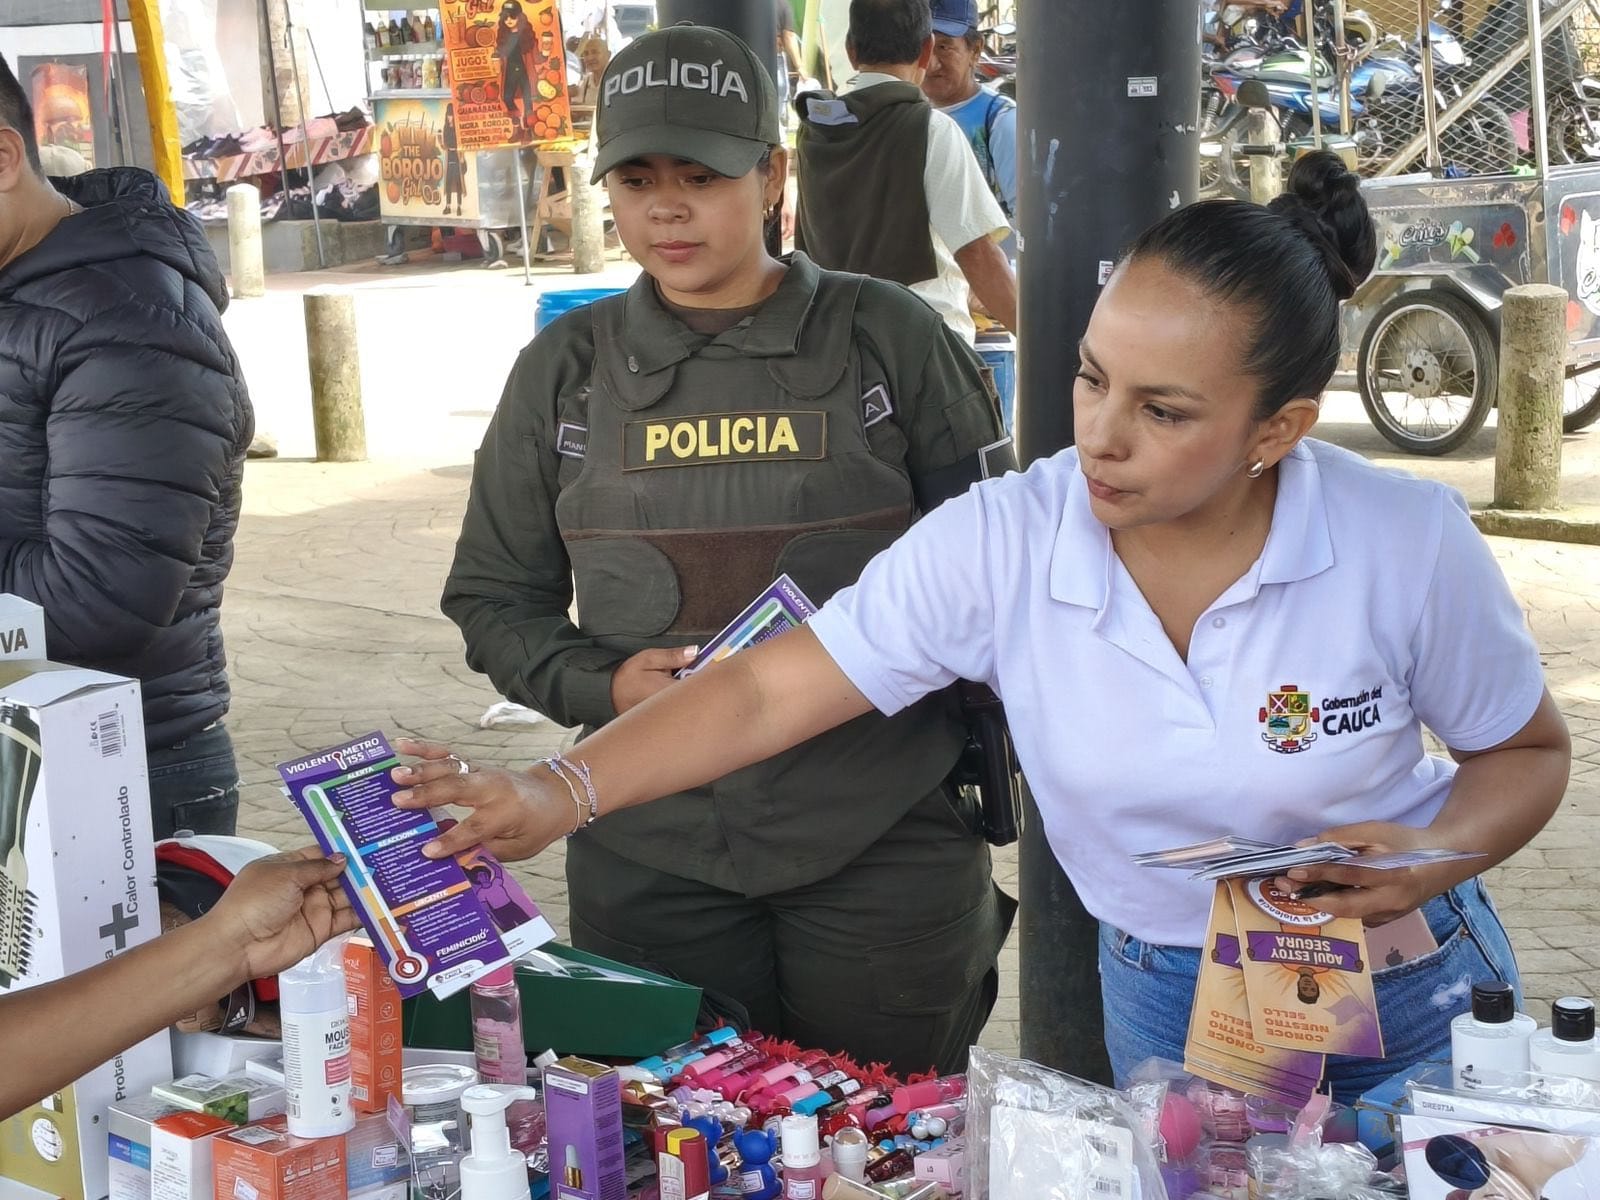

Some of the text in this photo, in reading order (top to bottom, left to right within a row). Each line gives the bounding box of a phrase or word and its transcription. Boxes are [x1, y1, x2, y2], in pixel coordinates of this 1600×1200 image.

[456, 56, 488, 67] JUGOS
[604, 58, 748, 106] POLICÍA
[403, 145, 420, 157] THE
[382, 157, 443, 180] BOROJO
[646, 416, 799, 461] POLICIA
[1322, 704, 1381, 736] CAUCA
[345, 752, 365, 765] 155
[347, 766, 374, 779] ALERTA
[377, 828, 418, 848] REACCIONA
[117, 785, 138, 914] Calor Controlado
[1258, 898, 1300, 923] Violencia
[436, 931, 488, 957] FEMINICIDIO
[1275, 935, 1331, 951] SEGURA
[1271, 948, 1310, 962] ESTOY
[1210, 1010, 1252, 1029] SELLO
[1263, 1007, 1306, 1020] SELLO
[1209, 1020, 1254, 1040] ESTRO
[1265, 1018, 1329, 1033] NUESTRO
[1266, 1028, 1324, 1042] CONOCE
[1207, 1030, 1265, 1054] CONOCE
